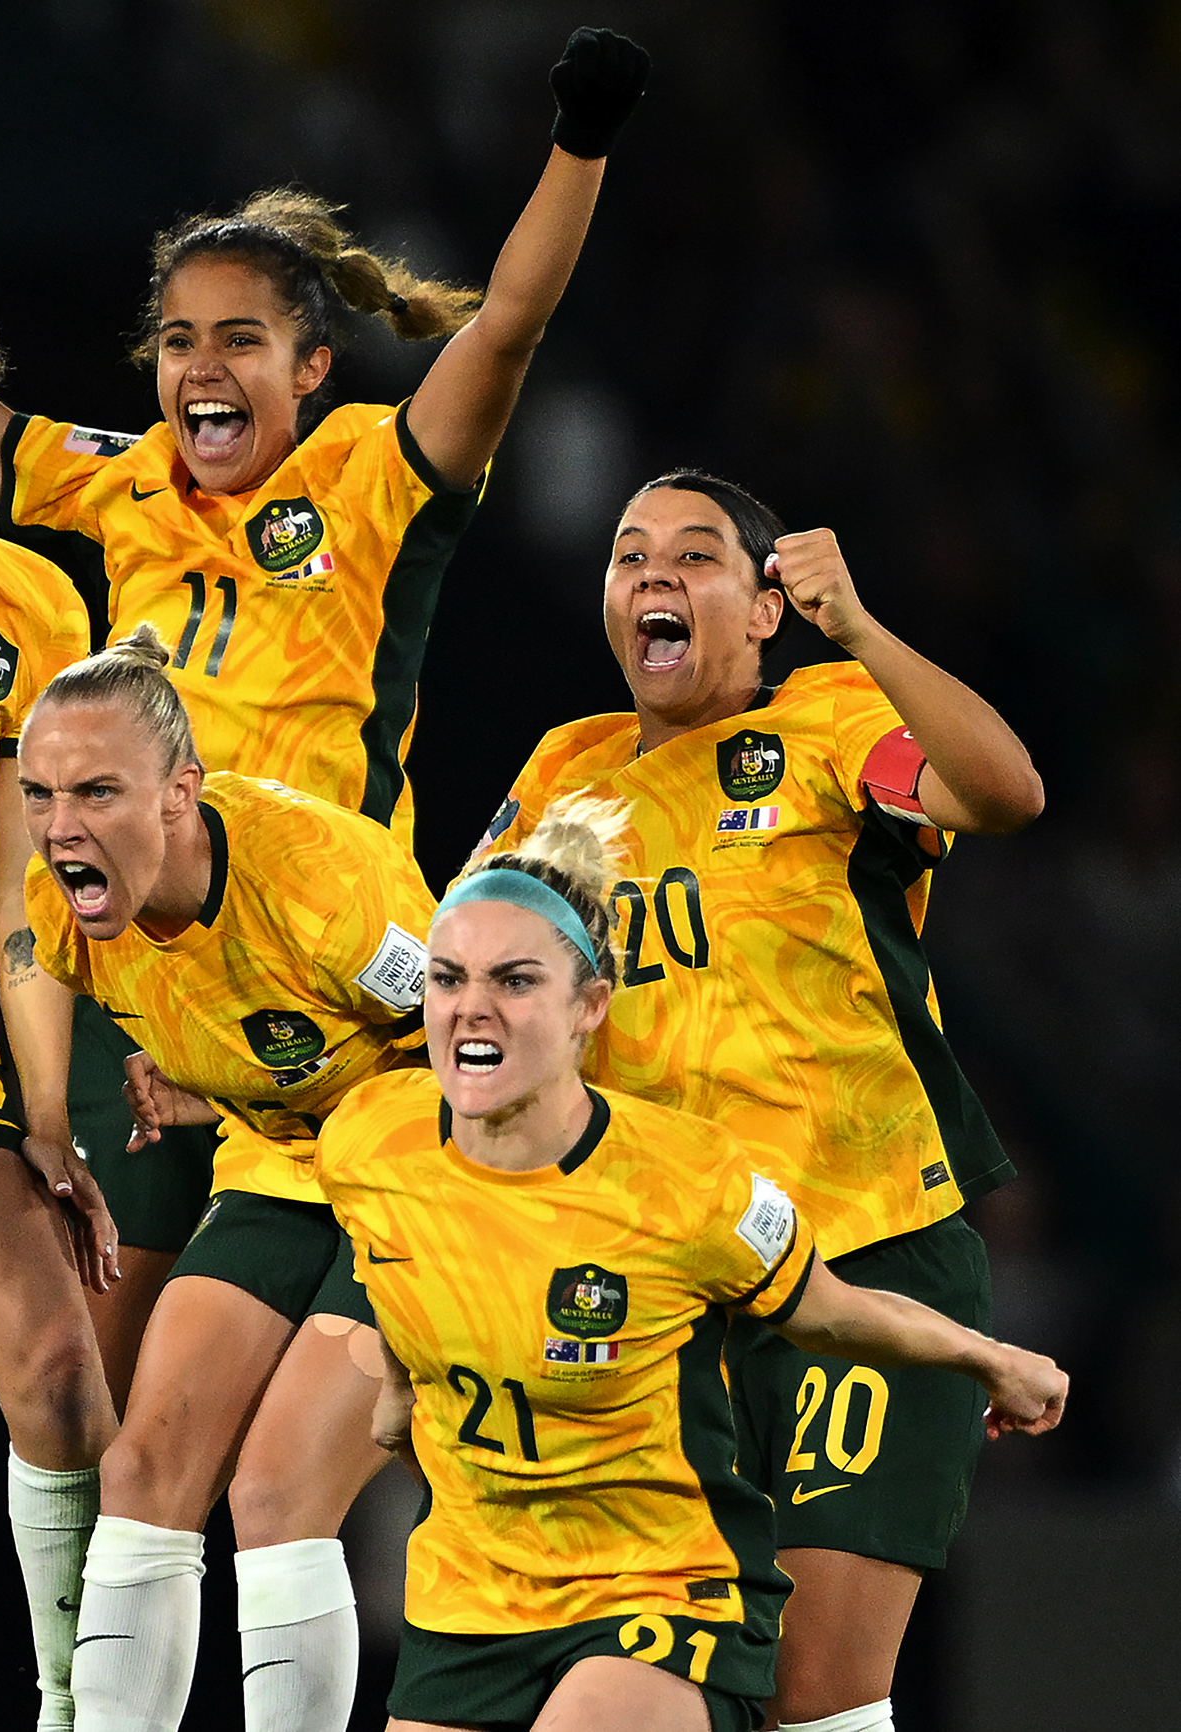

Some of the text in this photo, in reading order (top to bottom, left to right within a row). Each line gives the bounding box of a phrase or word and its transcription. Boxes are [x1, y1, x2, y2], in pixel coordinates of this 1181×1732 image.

[267, 532, 313, 559] AUSTRALIA
[172, 571, 237, 677] 11
[732, 774, 774, 785] AUSTRALIA
[606, 866, 709, 987] 20
[8, 971, 37, 990] PEACH
[373, 944, 402, 981] FOOTBALL
[382, 948, 411, 987] UNITES
[393, 982, 407, 995] the
[265, 1036, 313, 1052] AUSTRALIA
[559, 1308, 613, 1319] AUSTRALIA
[447, 1364, 539, 1462] 21
[785, 1365, 889, 1475] 20
[618, 1613, 717, 1684] 21
